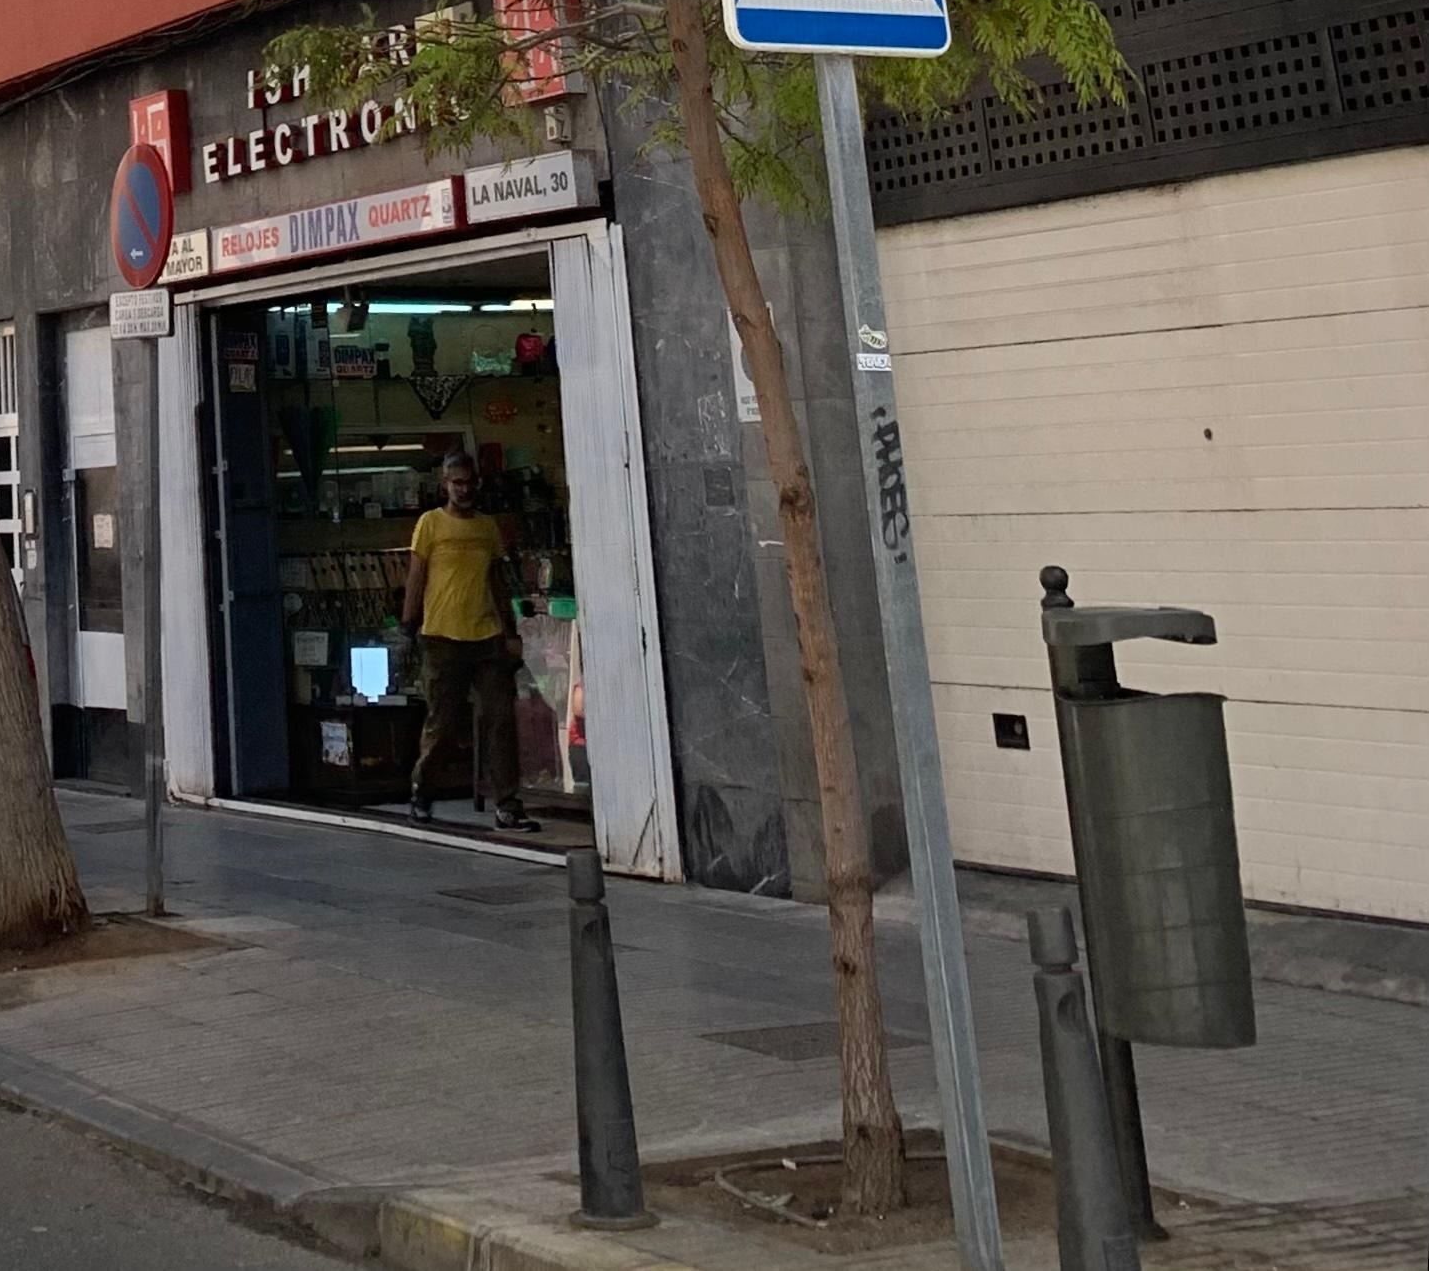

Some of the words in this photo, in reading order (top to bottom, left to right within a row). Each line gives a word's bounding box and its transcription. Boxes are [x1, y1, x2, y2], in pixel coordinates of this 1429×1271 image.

[472, 183, 491, 206] LA
[494, 174, 547, 203] NAVAL,
[550, 171, 569, 192] 30
[221, 226, 280, 257] RELOJES
[289, 201, 361, 253] DIMPAX
[368, 194, 431, 228] QUARTZ
[181, 237, 194, 254] AL
[166, 255, 203, 277] MAYOR
[335, 364, 375, 374] QUARTZ
